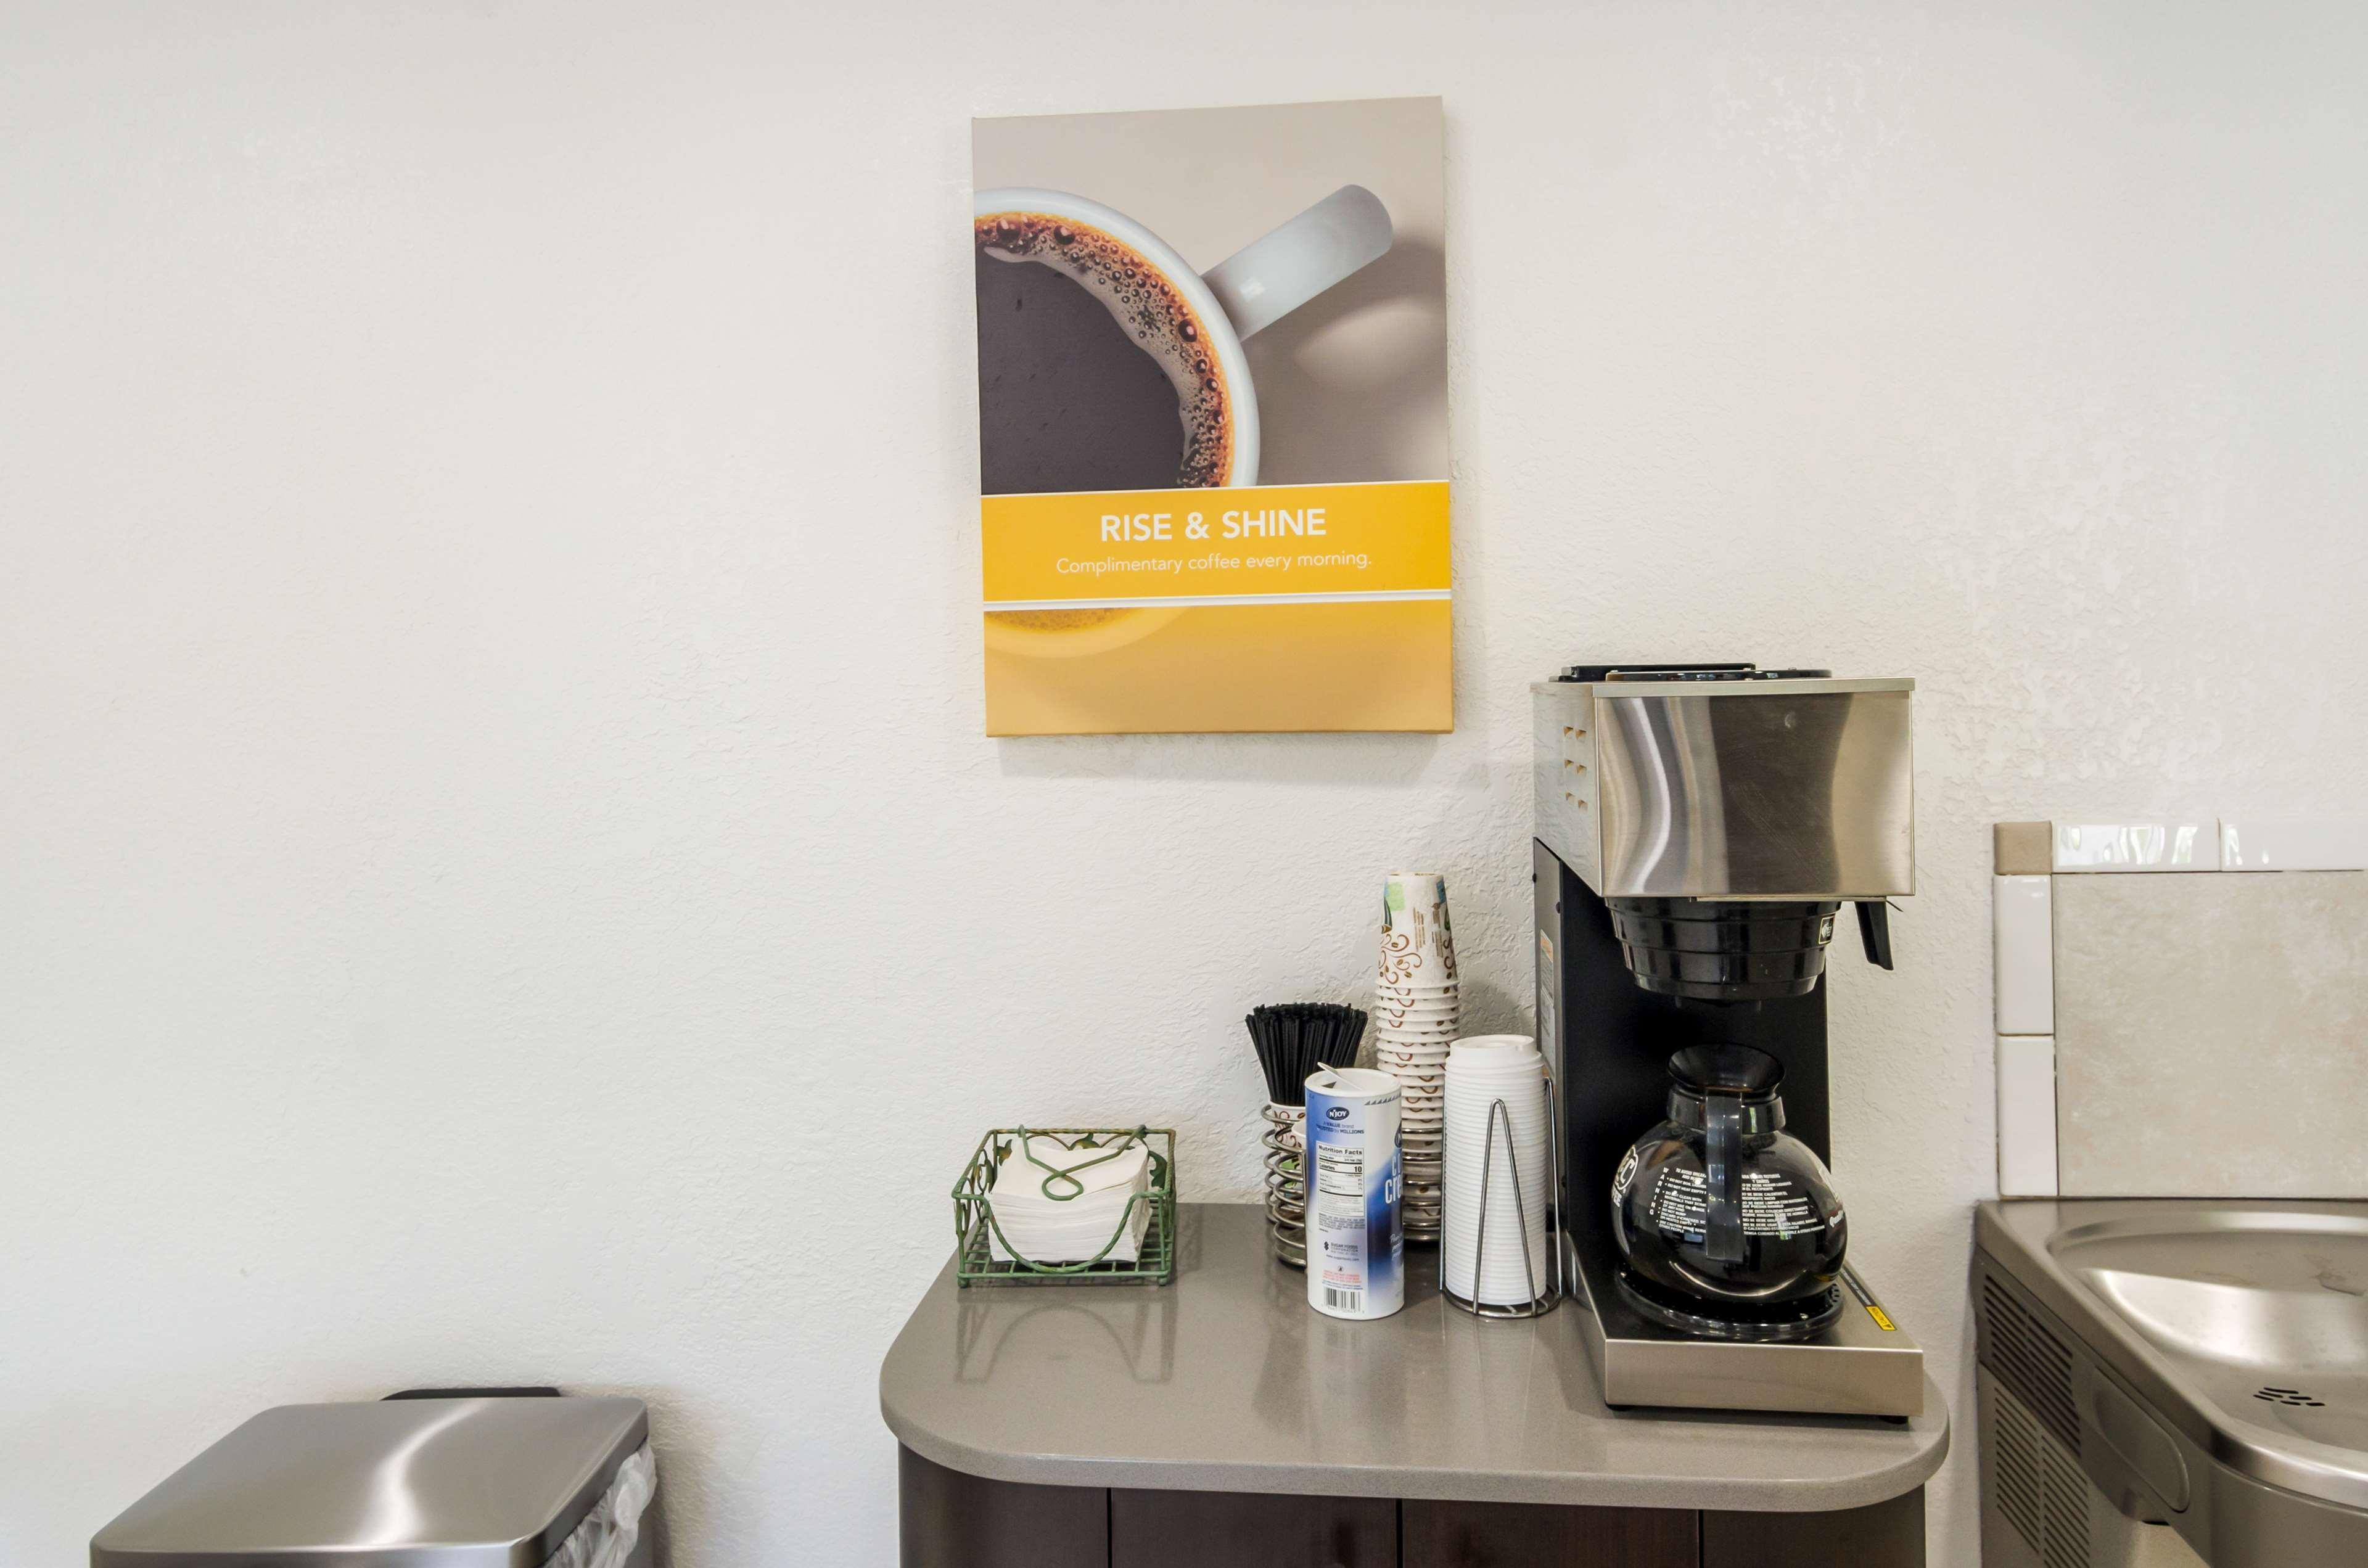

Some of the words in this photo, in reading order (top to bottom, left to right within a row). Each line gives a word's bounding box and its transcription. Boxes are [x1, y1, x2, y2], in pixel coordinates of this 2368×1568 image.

[1100, 512, 1172, 542] RISE
[1185, 511, 1210, 540] &
[1221, 508, 1327, 539] SHINE
[1056, 556, 1181, 577] Complimentary
[1188, 554, 1241, 571] coffee
[1245, 556, 1291, 571] every
[1297, 550, 1371, 570] morning.
[1319, 1145, 1342, 1154] Nutrition
